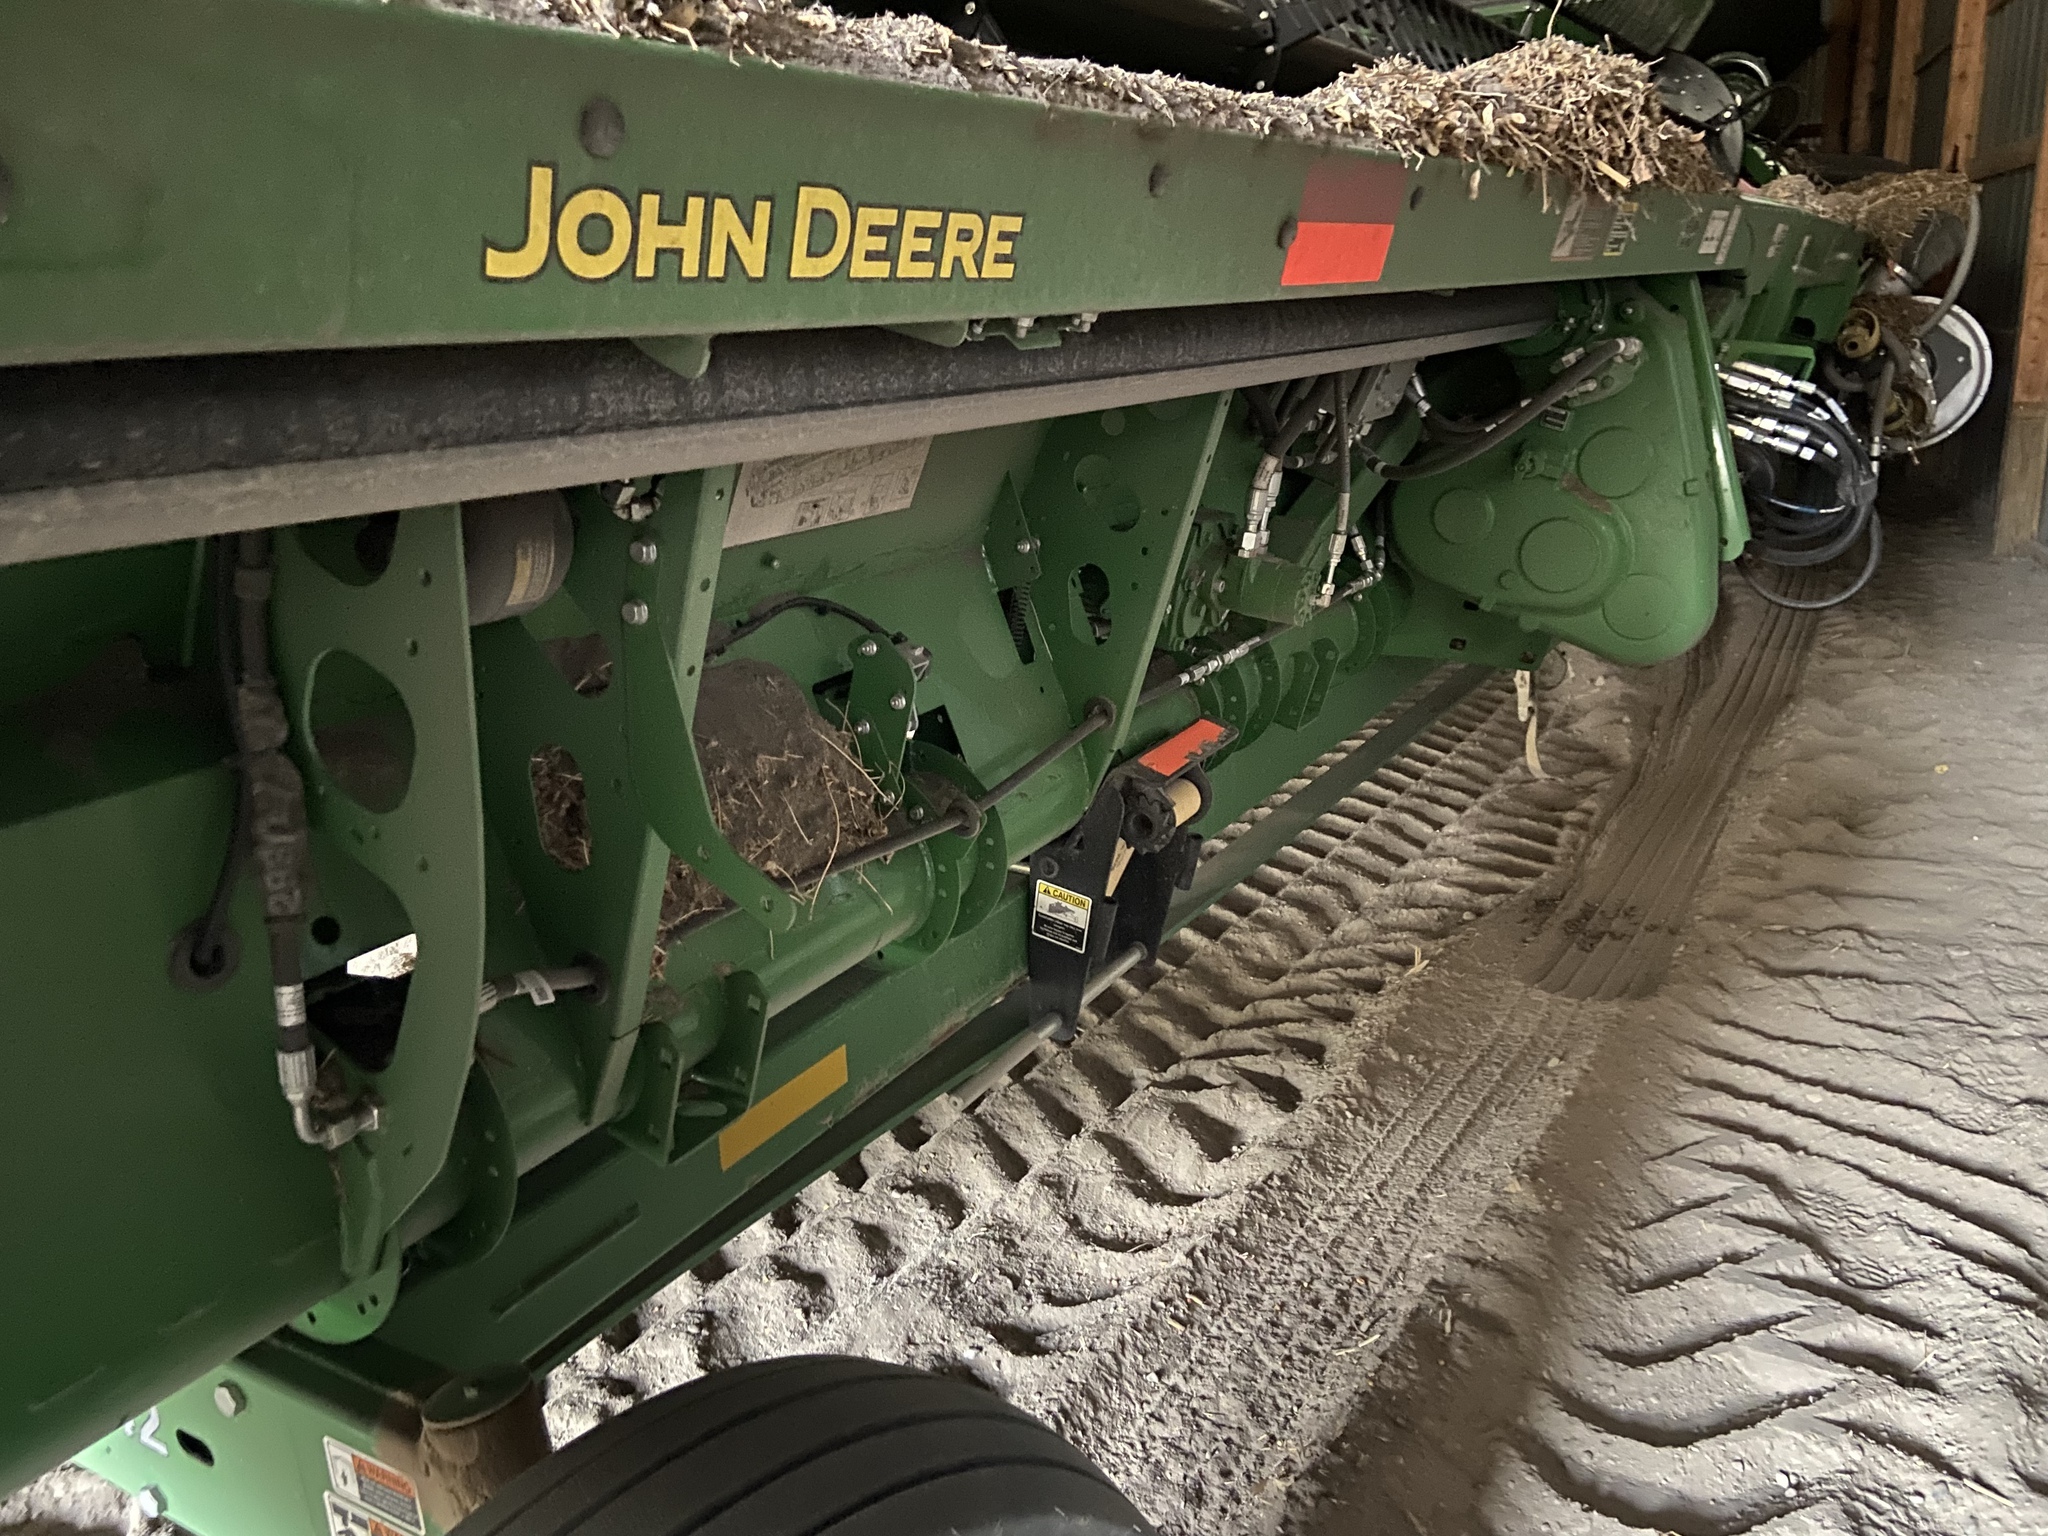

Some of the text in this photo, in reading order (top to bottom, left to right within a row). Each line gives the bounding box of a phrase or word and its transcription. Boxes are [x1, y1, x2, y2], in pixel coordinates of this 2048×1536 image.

[484, 165, 1024, 280] JOHN DEERE
[1052, 888, 1087, 908] CAUTION
